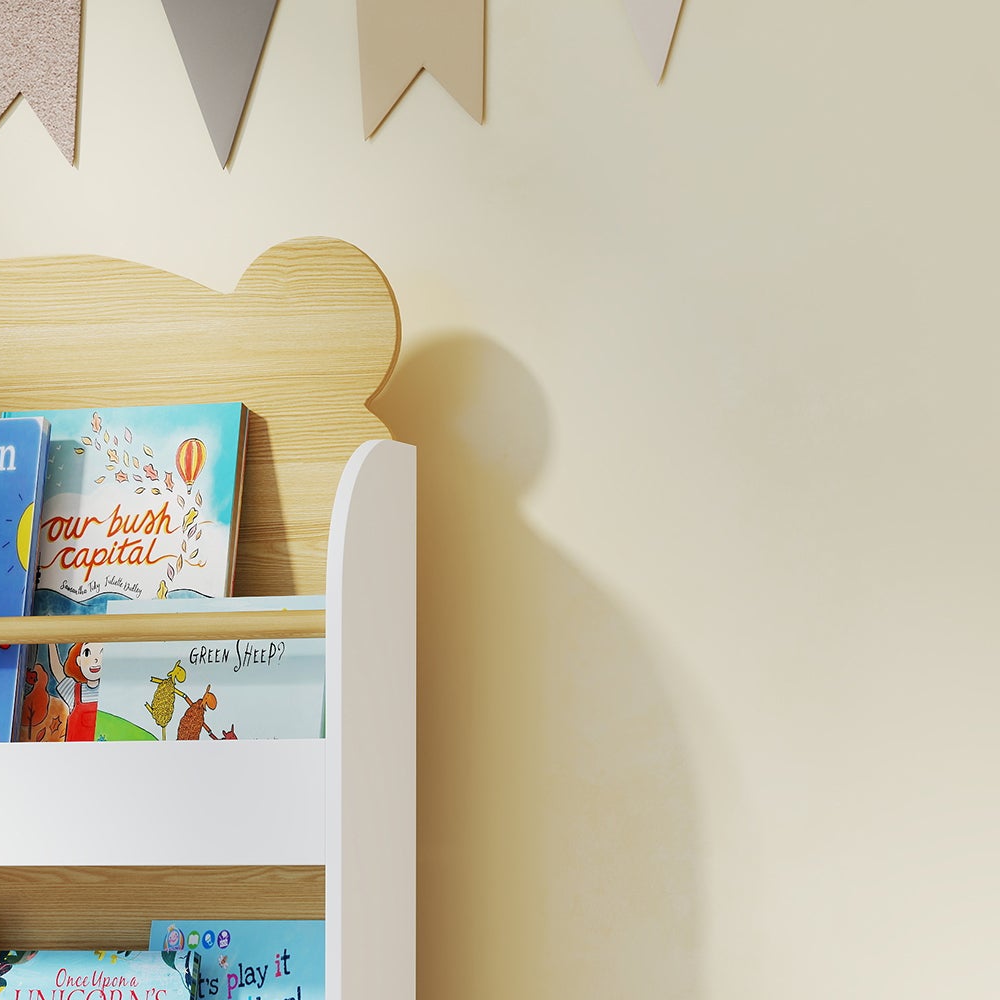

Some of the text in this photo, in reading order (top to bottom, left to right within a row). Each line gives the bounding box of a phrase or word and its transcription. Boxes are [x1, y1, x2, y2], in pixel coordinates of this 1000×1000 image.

[41, 501, 180, 542] our bush
[45, 538, 176, 583] capital
[189, 640, 285, 672] GREEN SHEEP?
[55, 968, 139, 998] Once Upon a
[198, 948, 291, 1000] t's play it
